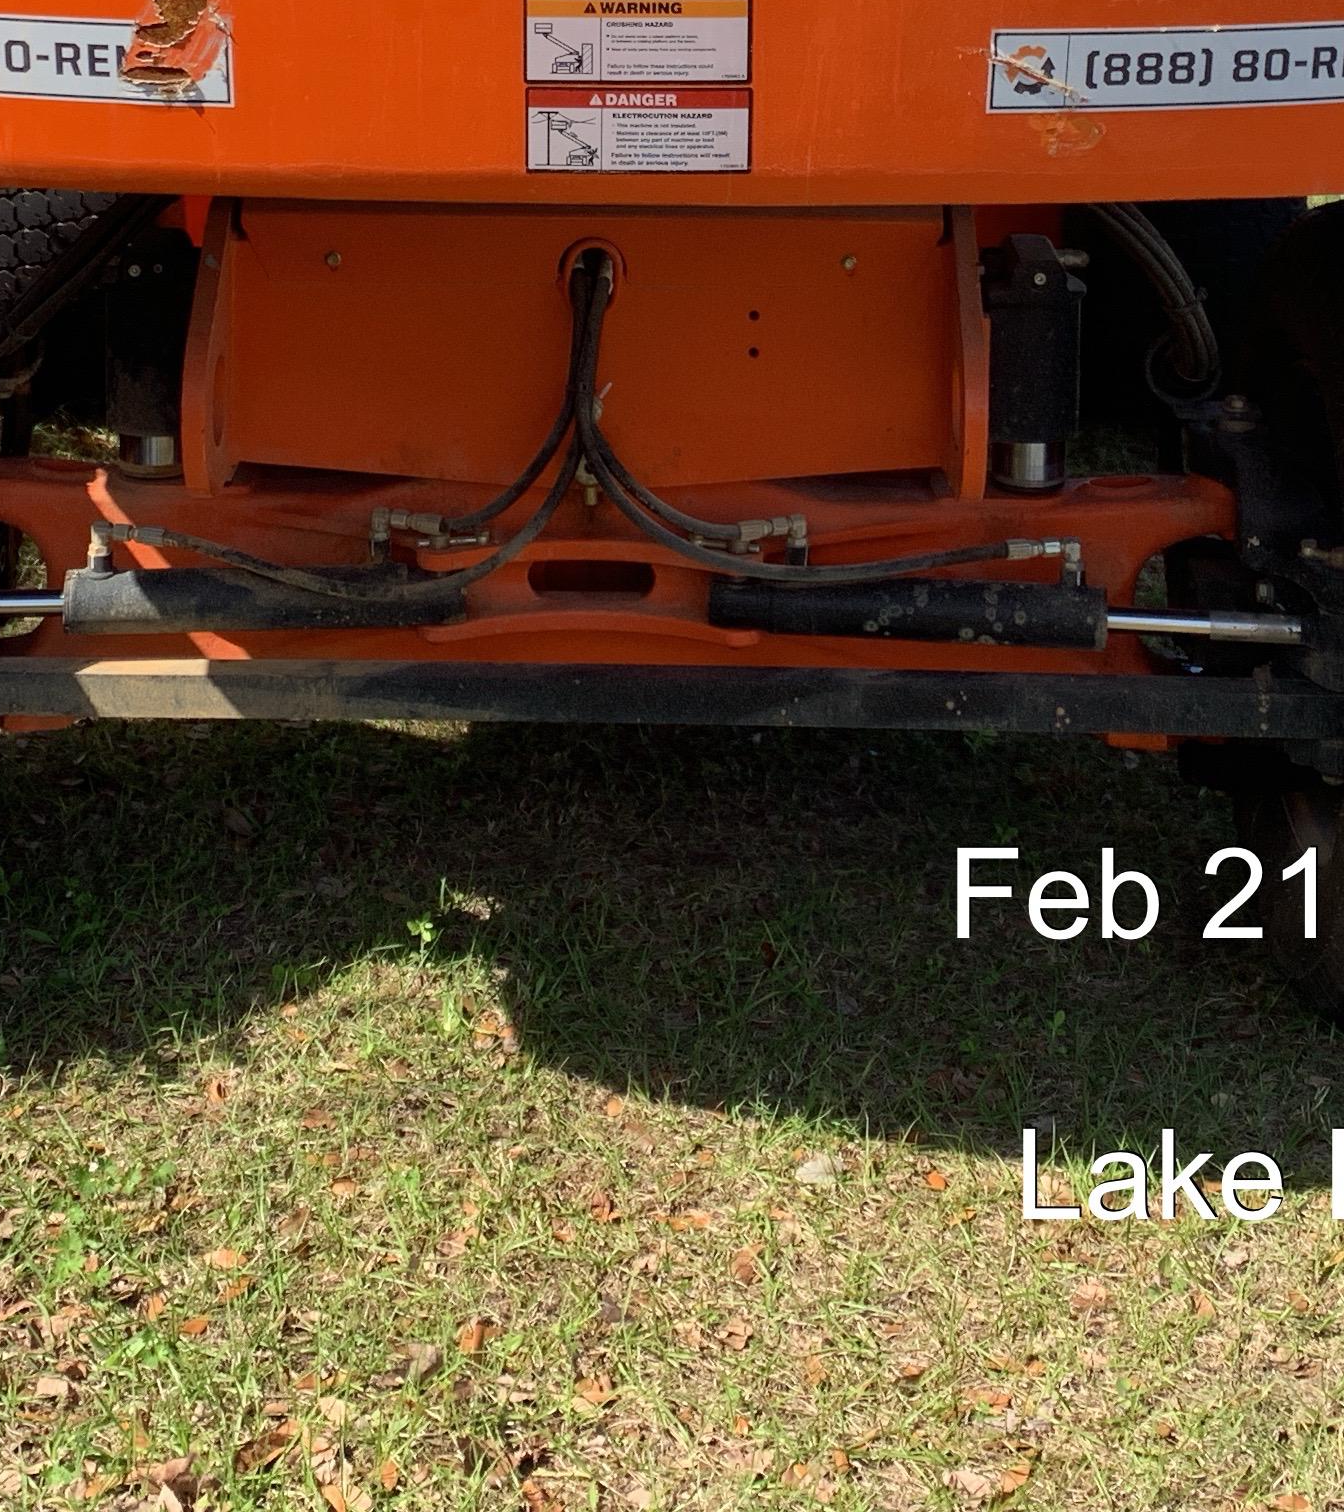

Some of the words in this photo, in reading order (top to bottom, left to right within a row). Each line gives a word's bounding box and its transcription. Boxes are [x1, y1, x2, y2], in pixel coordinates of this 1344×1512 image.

[600, 2, 683, 14] WARNING
[1084, 48, 1214, 88] (888)
[606, 94, 677, 106] DANGER
